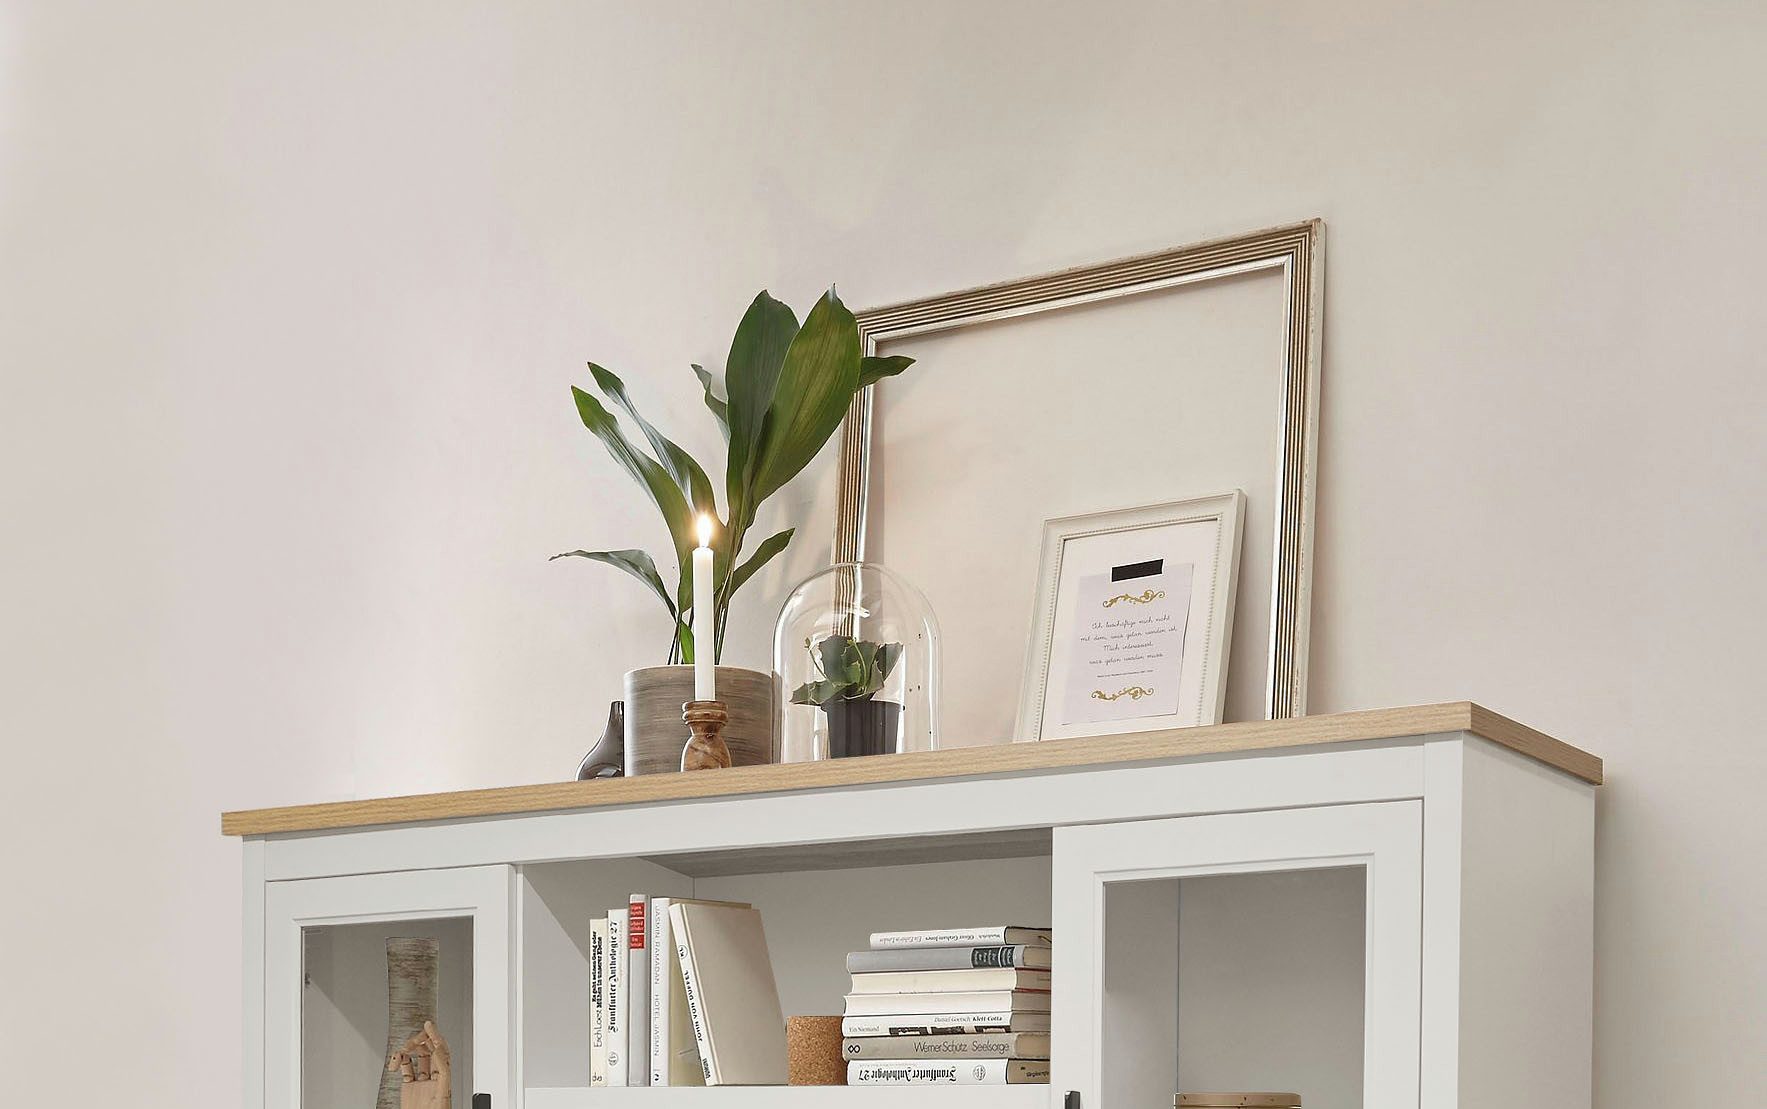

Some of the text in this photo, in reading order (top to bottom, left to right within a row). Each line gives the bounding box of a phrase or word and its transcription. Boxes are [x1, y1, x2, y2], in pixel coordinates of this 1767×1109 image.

[609, 921, 617, 935] 27
[608, 935, 619, 983] Anthologie
[971, 1040, 1010, 1055] Seelsorge
[859, 1066, 957, 1082] Frankfurter Anthologie 27
